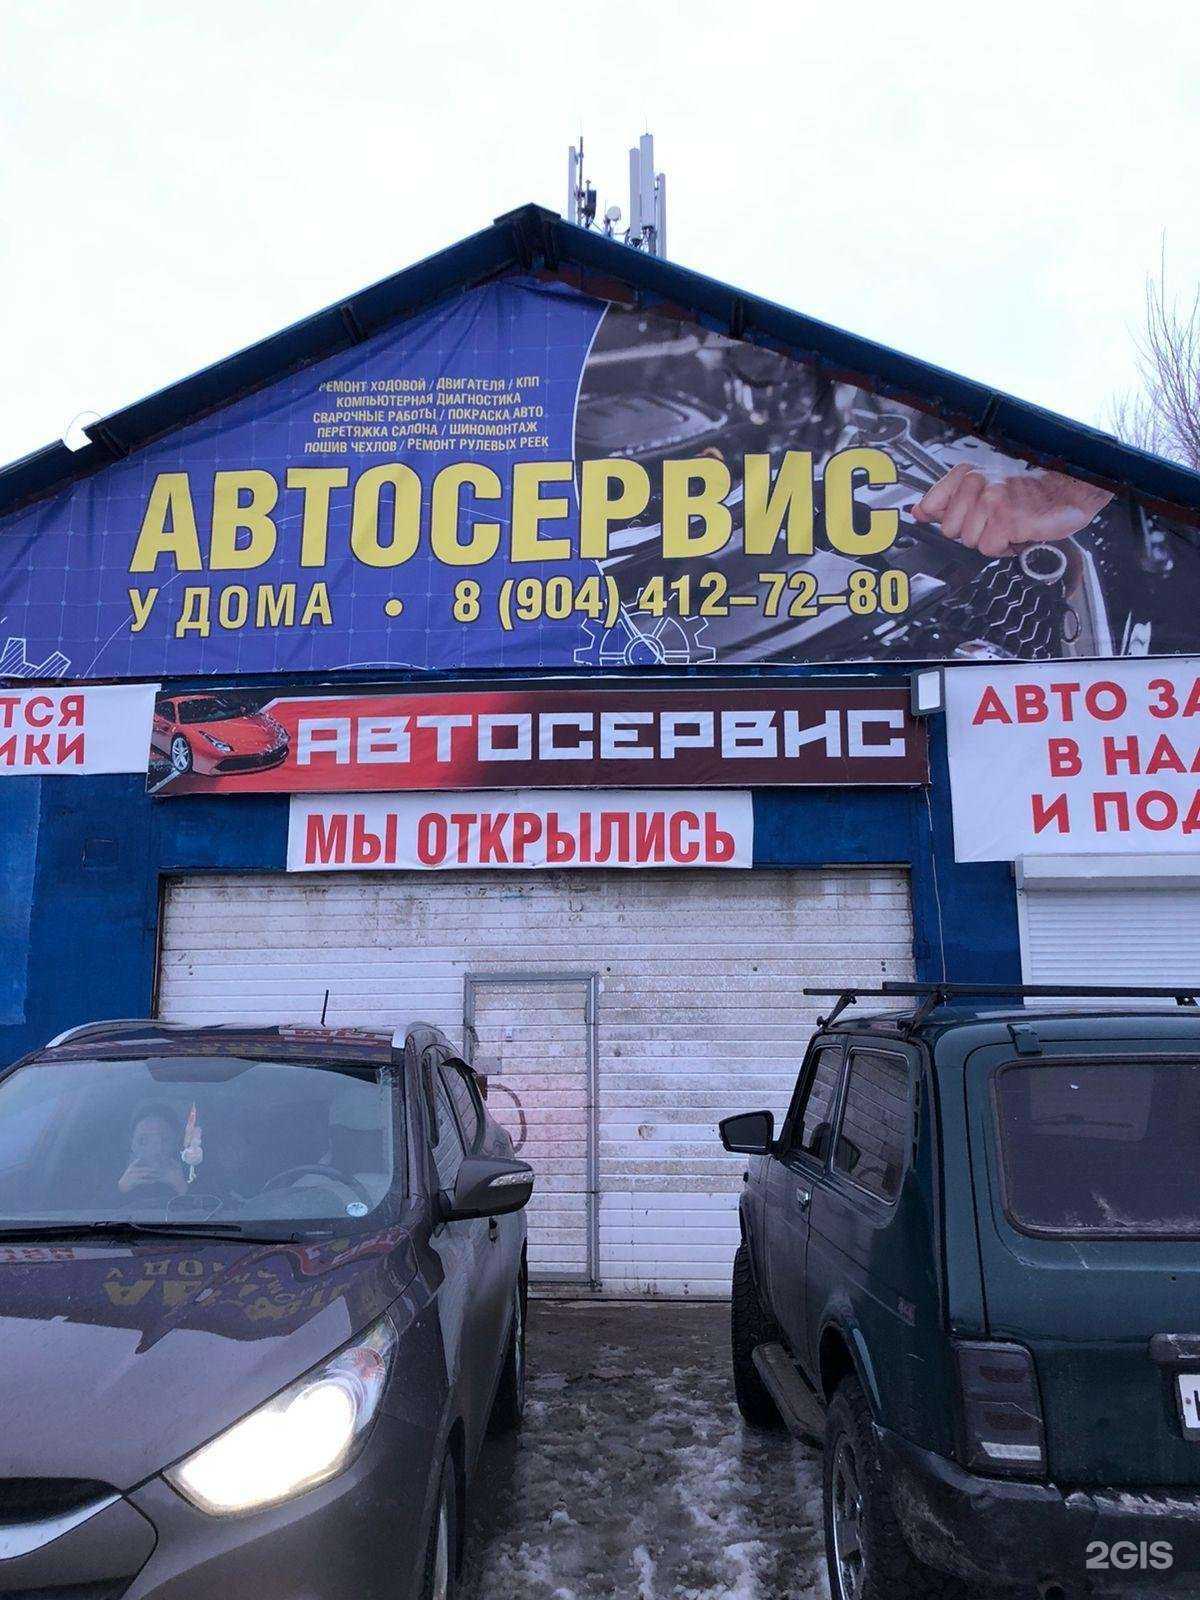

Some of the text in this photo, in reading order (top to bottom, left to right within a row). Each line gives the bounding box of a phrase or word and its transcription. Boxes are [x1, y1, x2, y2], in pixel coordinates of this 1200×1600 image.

[319, 380, 367, 392] РЕМОНТ
[371, 378, 425, 392] ХОДОВОЙ
[436, 377, 505, 391] ДВИГАТЕЛЯ
[516, 376, 539, 388] КПП
[336, 392, 520, 407] КОМПЬЮТЕРНАЯ ДИАГНОСТИКА
[313, 410, 384, 423] СВАРОЧНЫЕ
[388, 408, 436, 421] РАБОТЫ
[448, 408, 509, 421] ПОКРАСКА
[513, 406, 543, 418] АВТО
[317, 426, 388, 438] ПЕРЕТЯЖКА
[392, 423, 438, 437] САЛОНА
[450, 421, 537, 436] ШИНОМОНТАЖ
[304, 441, 347, 453] ПОШИВ
[351, 440, 397, 453] ЧЕХЛОВ
[408, 438, 456, 450] РЕМОНТ
[460, 438, 516, 451] РУЛЕВЫХ
[520, 436, 549, 448] РЕЕК
[129, 447, 900, 573] АВТОСЕРВИС
[128, 568, 910, 639] У ДОМА 8 (904) 412-72-80
[0, 694, 85, 728] ТСЯ
[972, 679, 1127, 725] АВТО
[297, 709, 906, 765] АВТОСЕРВИС
[1048, 733, 1200, 777] В НА
[1031, 793, 1070, 834] И
[304, 810, 736, 865] МЫ ОТКРЫЛИСЬ
